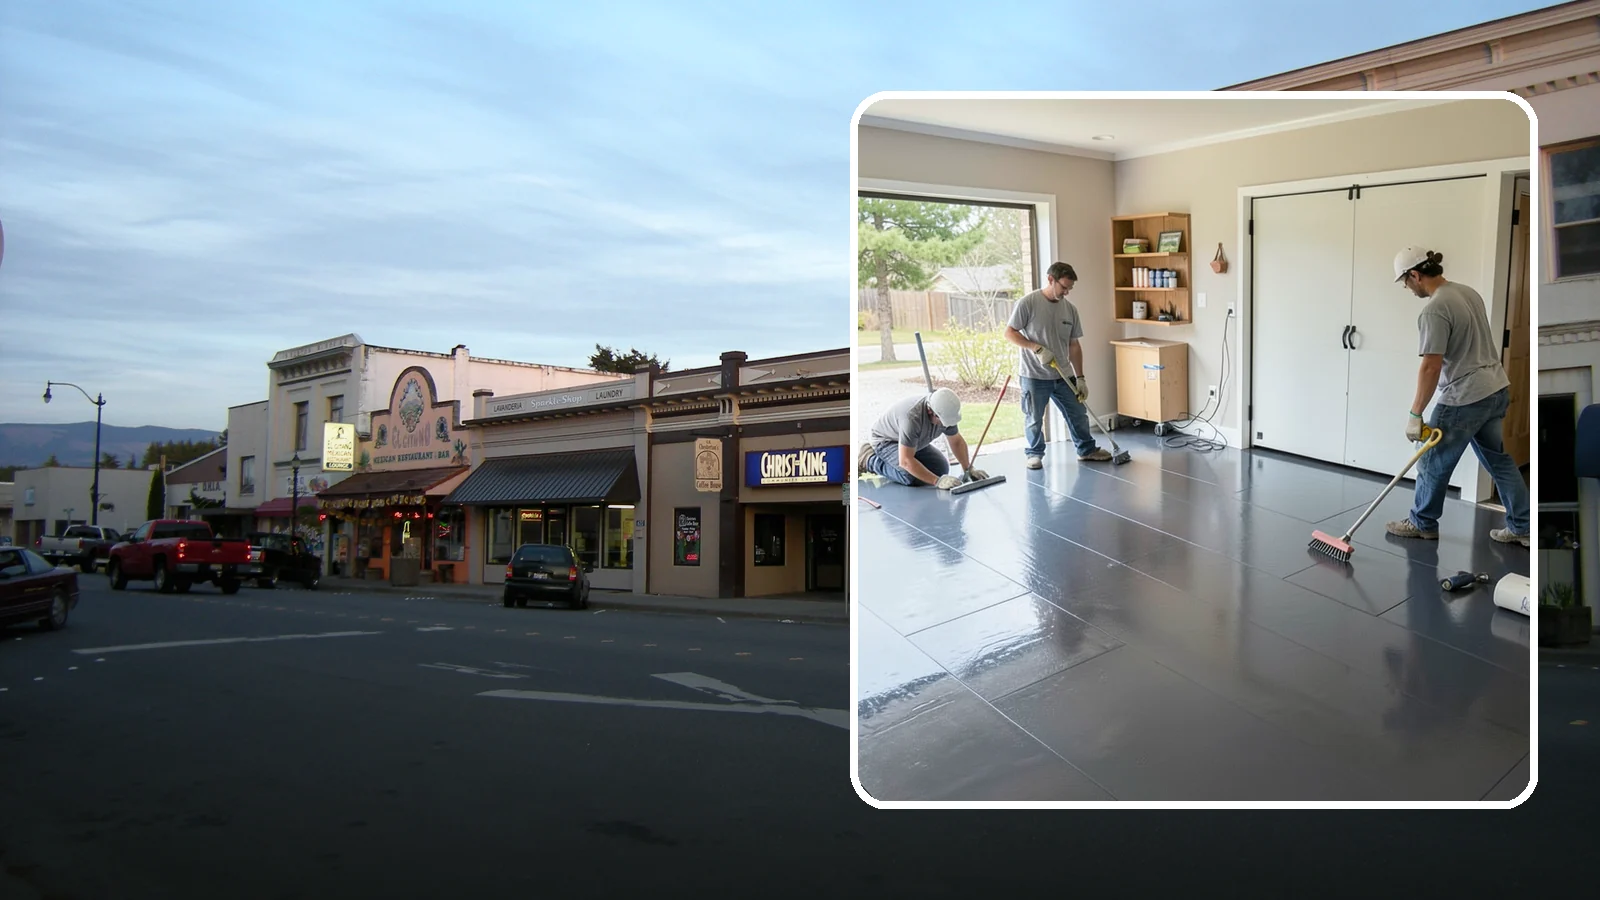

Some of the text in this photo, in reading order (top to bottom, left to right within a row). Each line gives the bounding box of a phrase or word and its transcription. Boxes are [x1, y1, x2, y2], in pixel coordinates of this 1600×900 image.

[494, 389, 623, 412] LAVANDERIA Sparkle Shop LAUNDRY
[374, 454, 396, 464] MEXICAN
[398, 451, 433, 462] RESTAURANT
[438, 450, 450, 458] BAR
[800, 450, 827, 476] KING
